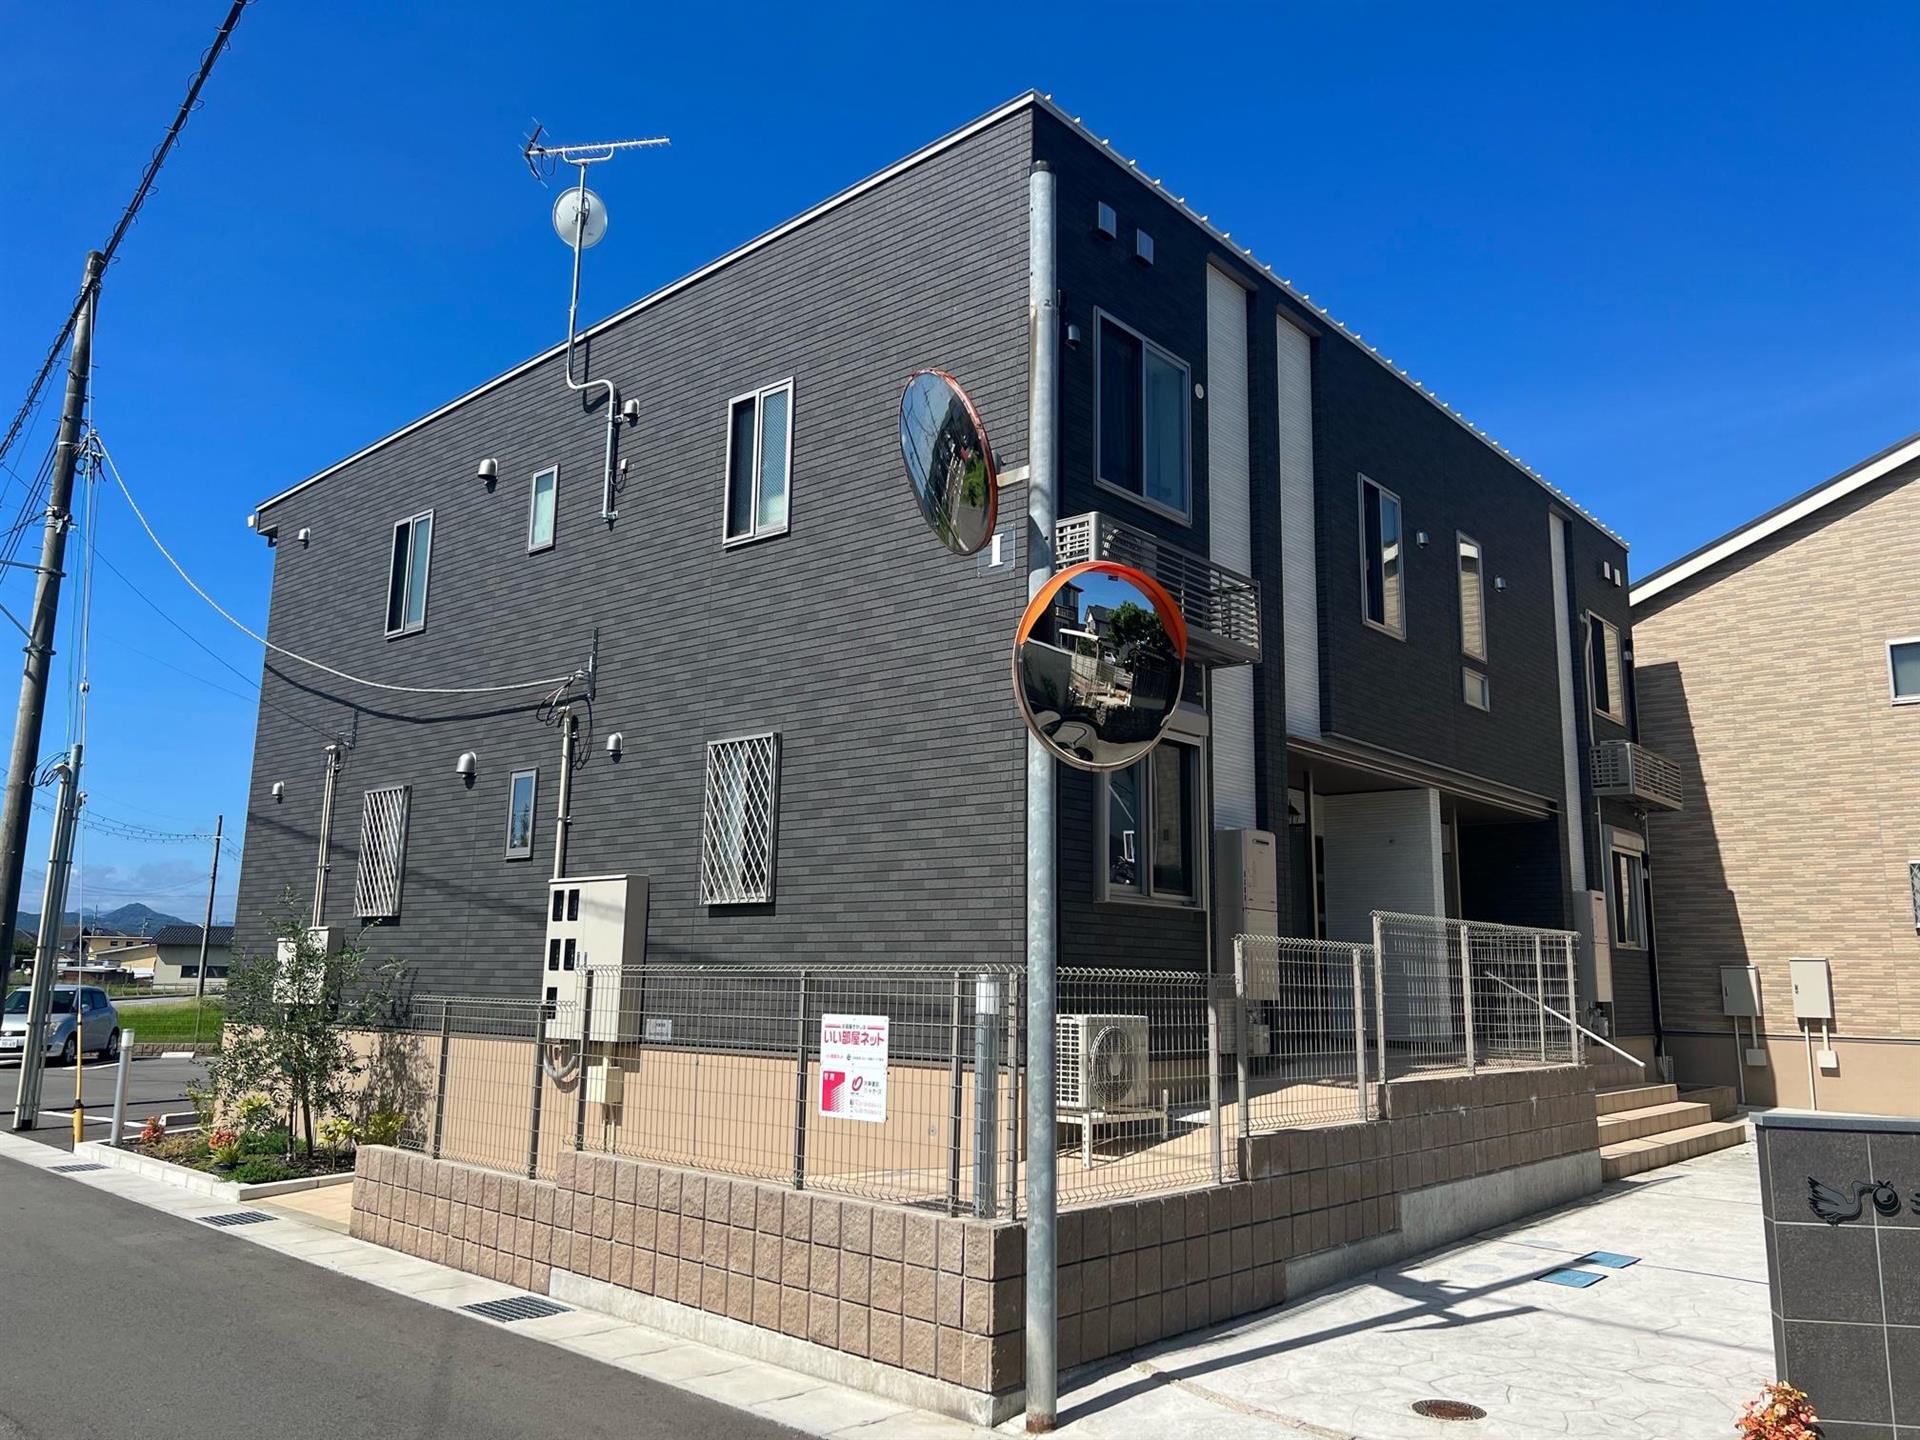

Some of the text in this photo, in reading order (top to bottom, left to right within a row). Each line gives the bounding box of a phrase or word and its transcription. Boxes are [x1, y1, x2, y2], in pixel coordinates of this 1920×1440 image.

[824, 1030, 885, 1046] いい部屋ネット
